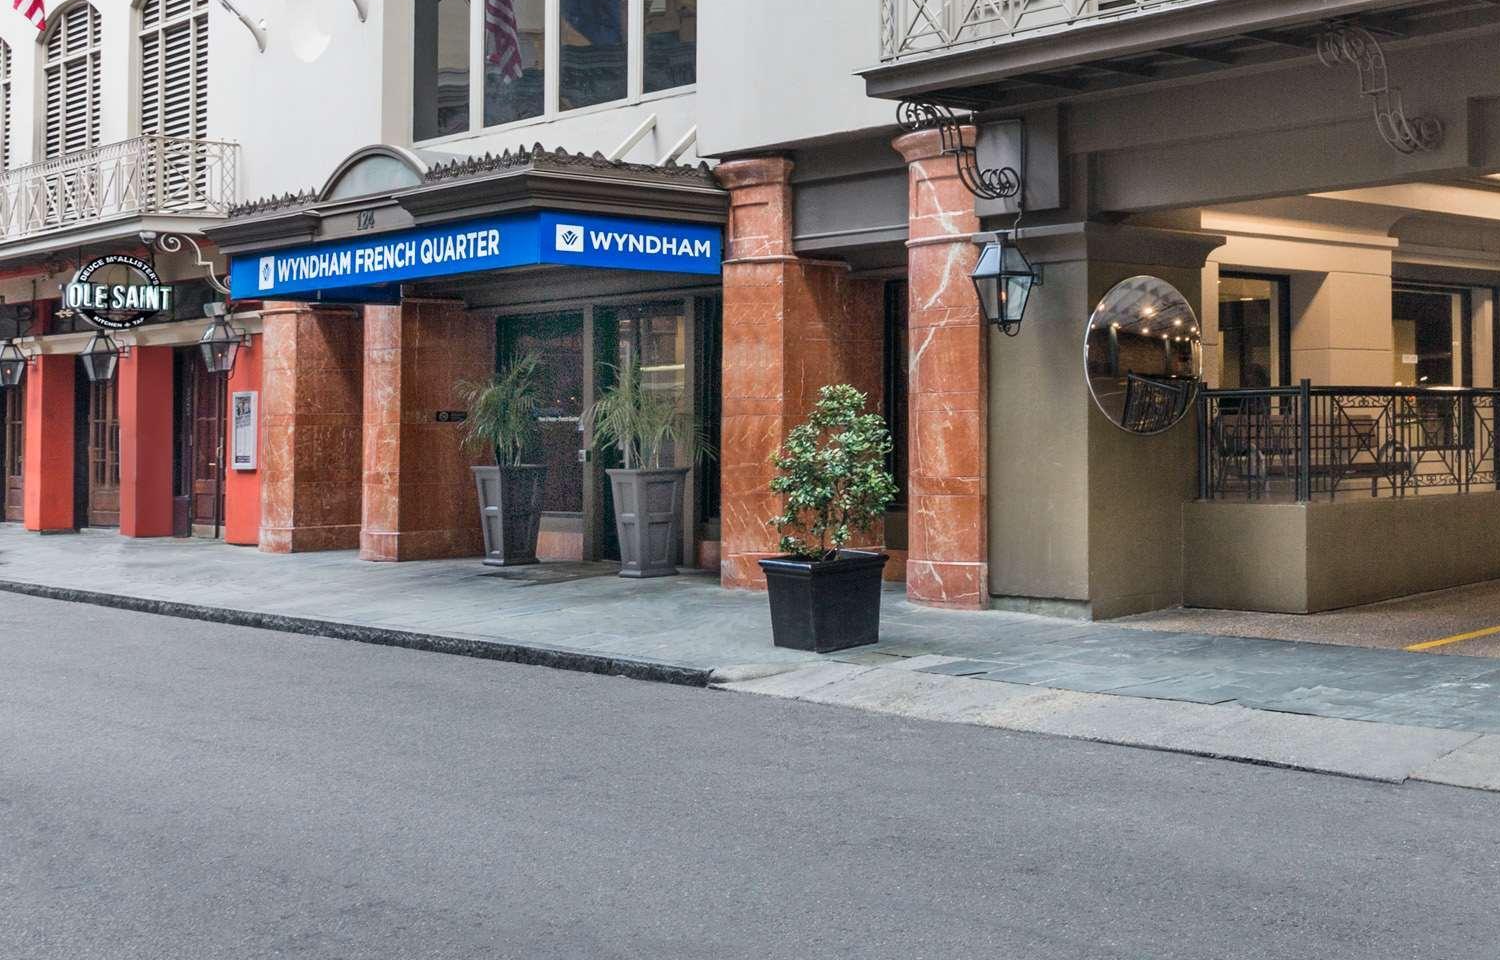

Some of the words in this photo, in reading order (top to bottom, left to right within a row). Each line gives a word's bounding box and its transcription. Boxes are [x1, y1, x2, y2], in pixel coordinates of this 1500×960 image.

[357, 210, 375, 230] 124
[277, 251, 351, 282] WYNDHAM
[354, 241, 416, 273] FRENCH
[420, 229, 500, 264] QUARTER
[589, 230, 711, 258] WYNDHAM
[79, 259, 105, 281] DEUCE
[69, 284, 107, 308] OLE
[112, 285, 172, 311] SAINT
[93, 315, 122, 328] KITCHEN
